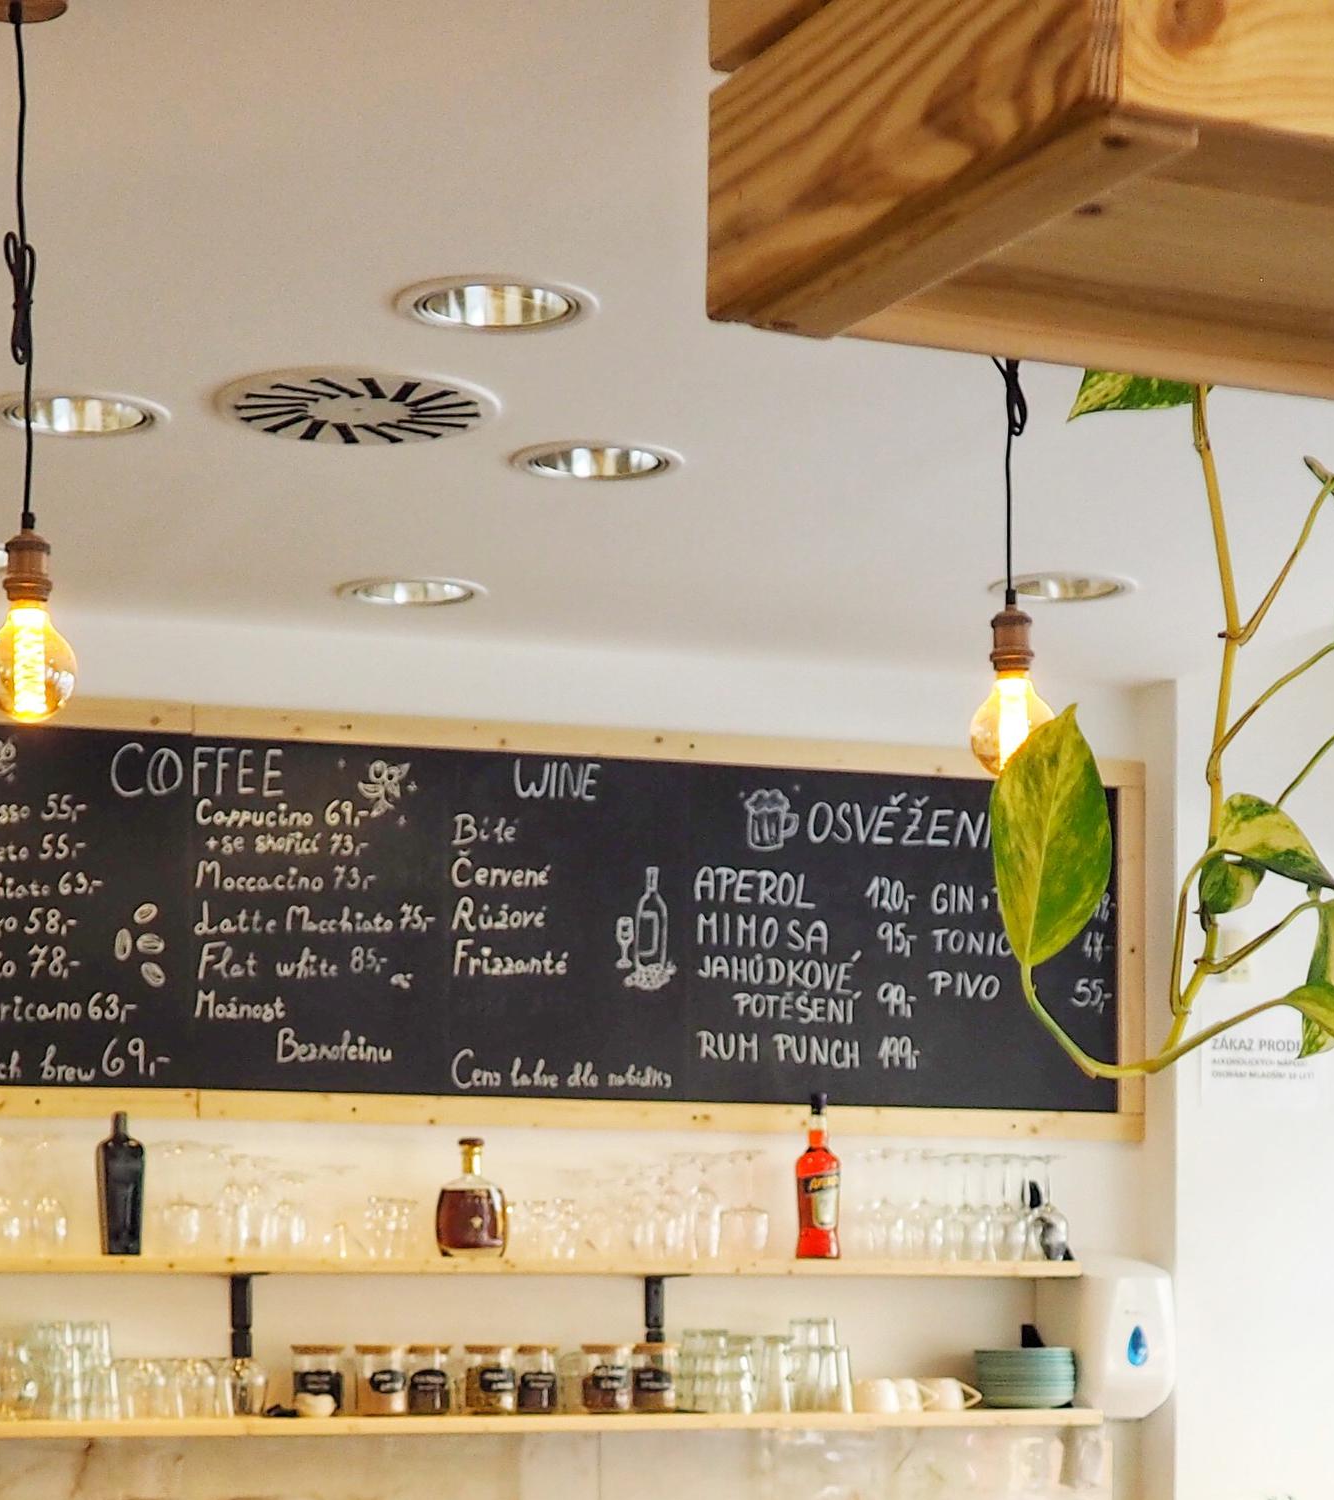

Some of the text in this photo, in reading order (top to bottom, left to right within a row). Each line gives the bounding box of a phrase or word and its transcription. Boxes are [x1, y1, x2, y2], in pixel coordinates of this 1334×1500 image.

[110, 743, 284, 798] COFFEE
[514, 758, 601, 801] WINE
[195, 798, 314, 828] Cappucino
[195, 860, 324, 893] Moccacino
[451, 848, 552, 888] Červené
[693, 865, 816, 910] APEROL
[930, 882, 974, 915] GIN
[194, 900, 277, 936] Latte
[286, 904, 393, 934] Macchiato
[697, 911, 829, 955] MIMOSA
[198, 940, 258, 981] Flat
[275, 946, 339, 980] white
[931, 928, 1012, 957] TONIC
[927, 969, 1001, 1001] PIVO
[732, 991, 862, 1025] POTĚŠENÍ
[696, 1030, 758, 1063] RUM
[772, 1033, 860, 1069] PUNCH
[1211, 1035, 1253, 1052] ZÁKAZ
[40, 1043, 95, 1082] brew
